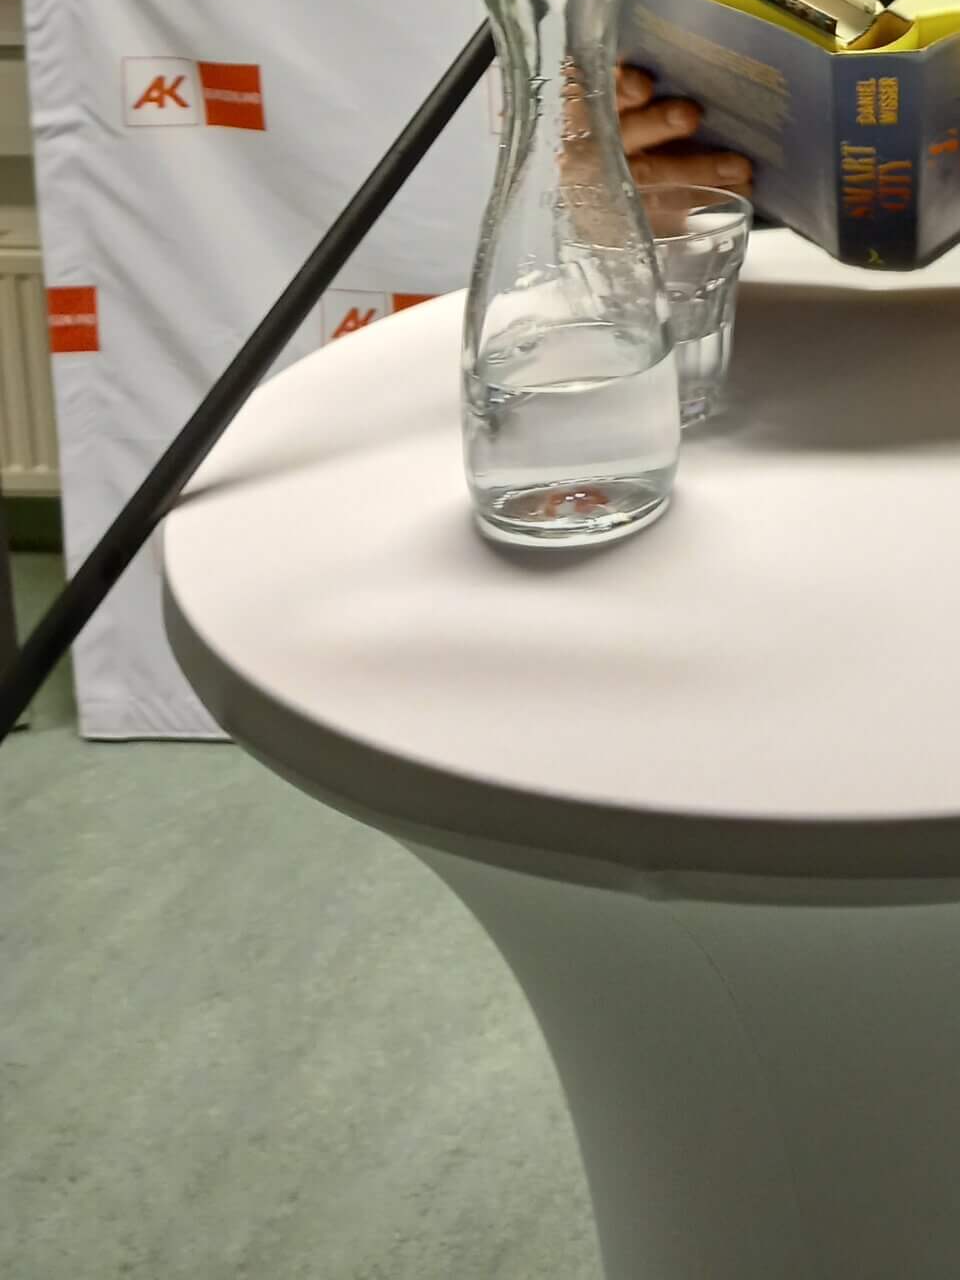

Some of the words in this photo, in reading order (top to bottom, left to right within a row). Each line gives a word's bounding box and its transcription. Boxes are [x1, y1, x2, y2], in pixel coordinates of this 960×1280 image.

[132, 75, 190, 109] AK
[856, 78, 877, 126] DANIEL
[879, 76, 899, 125] WISSER
